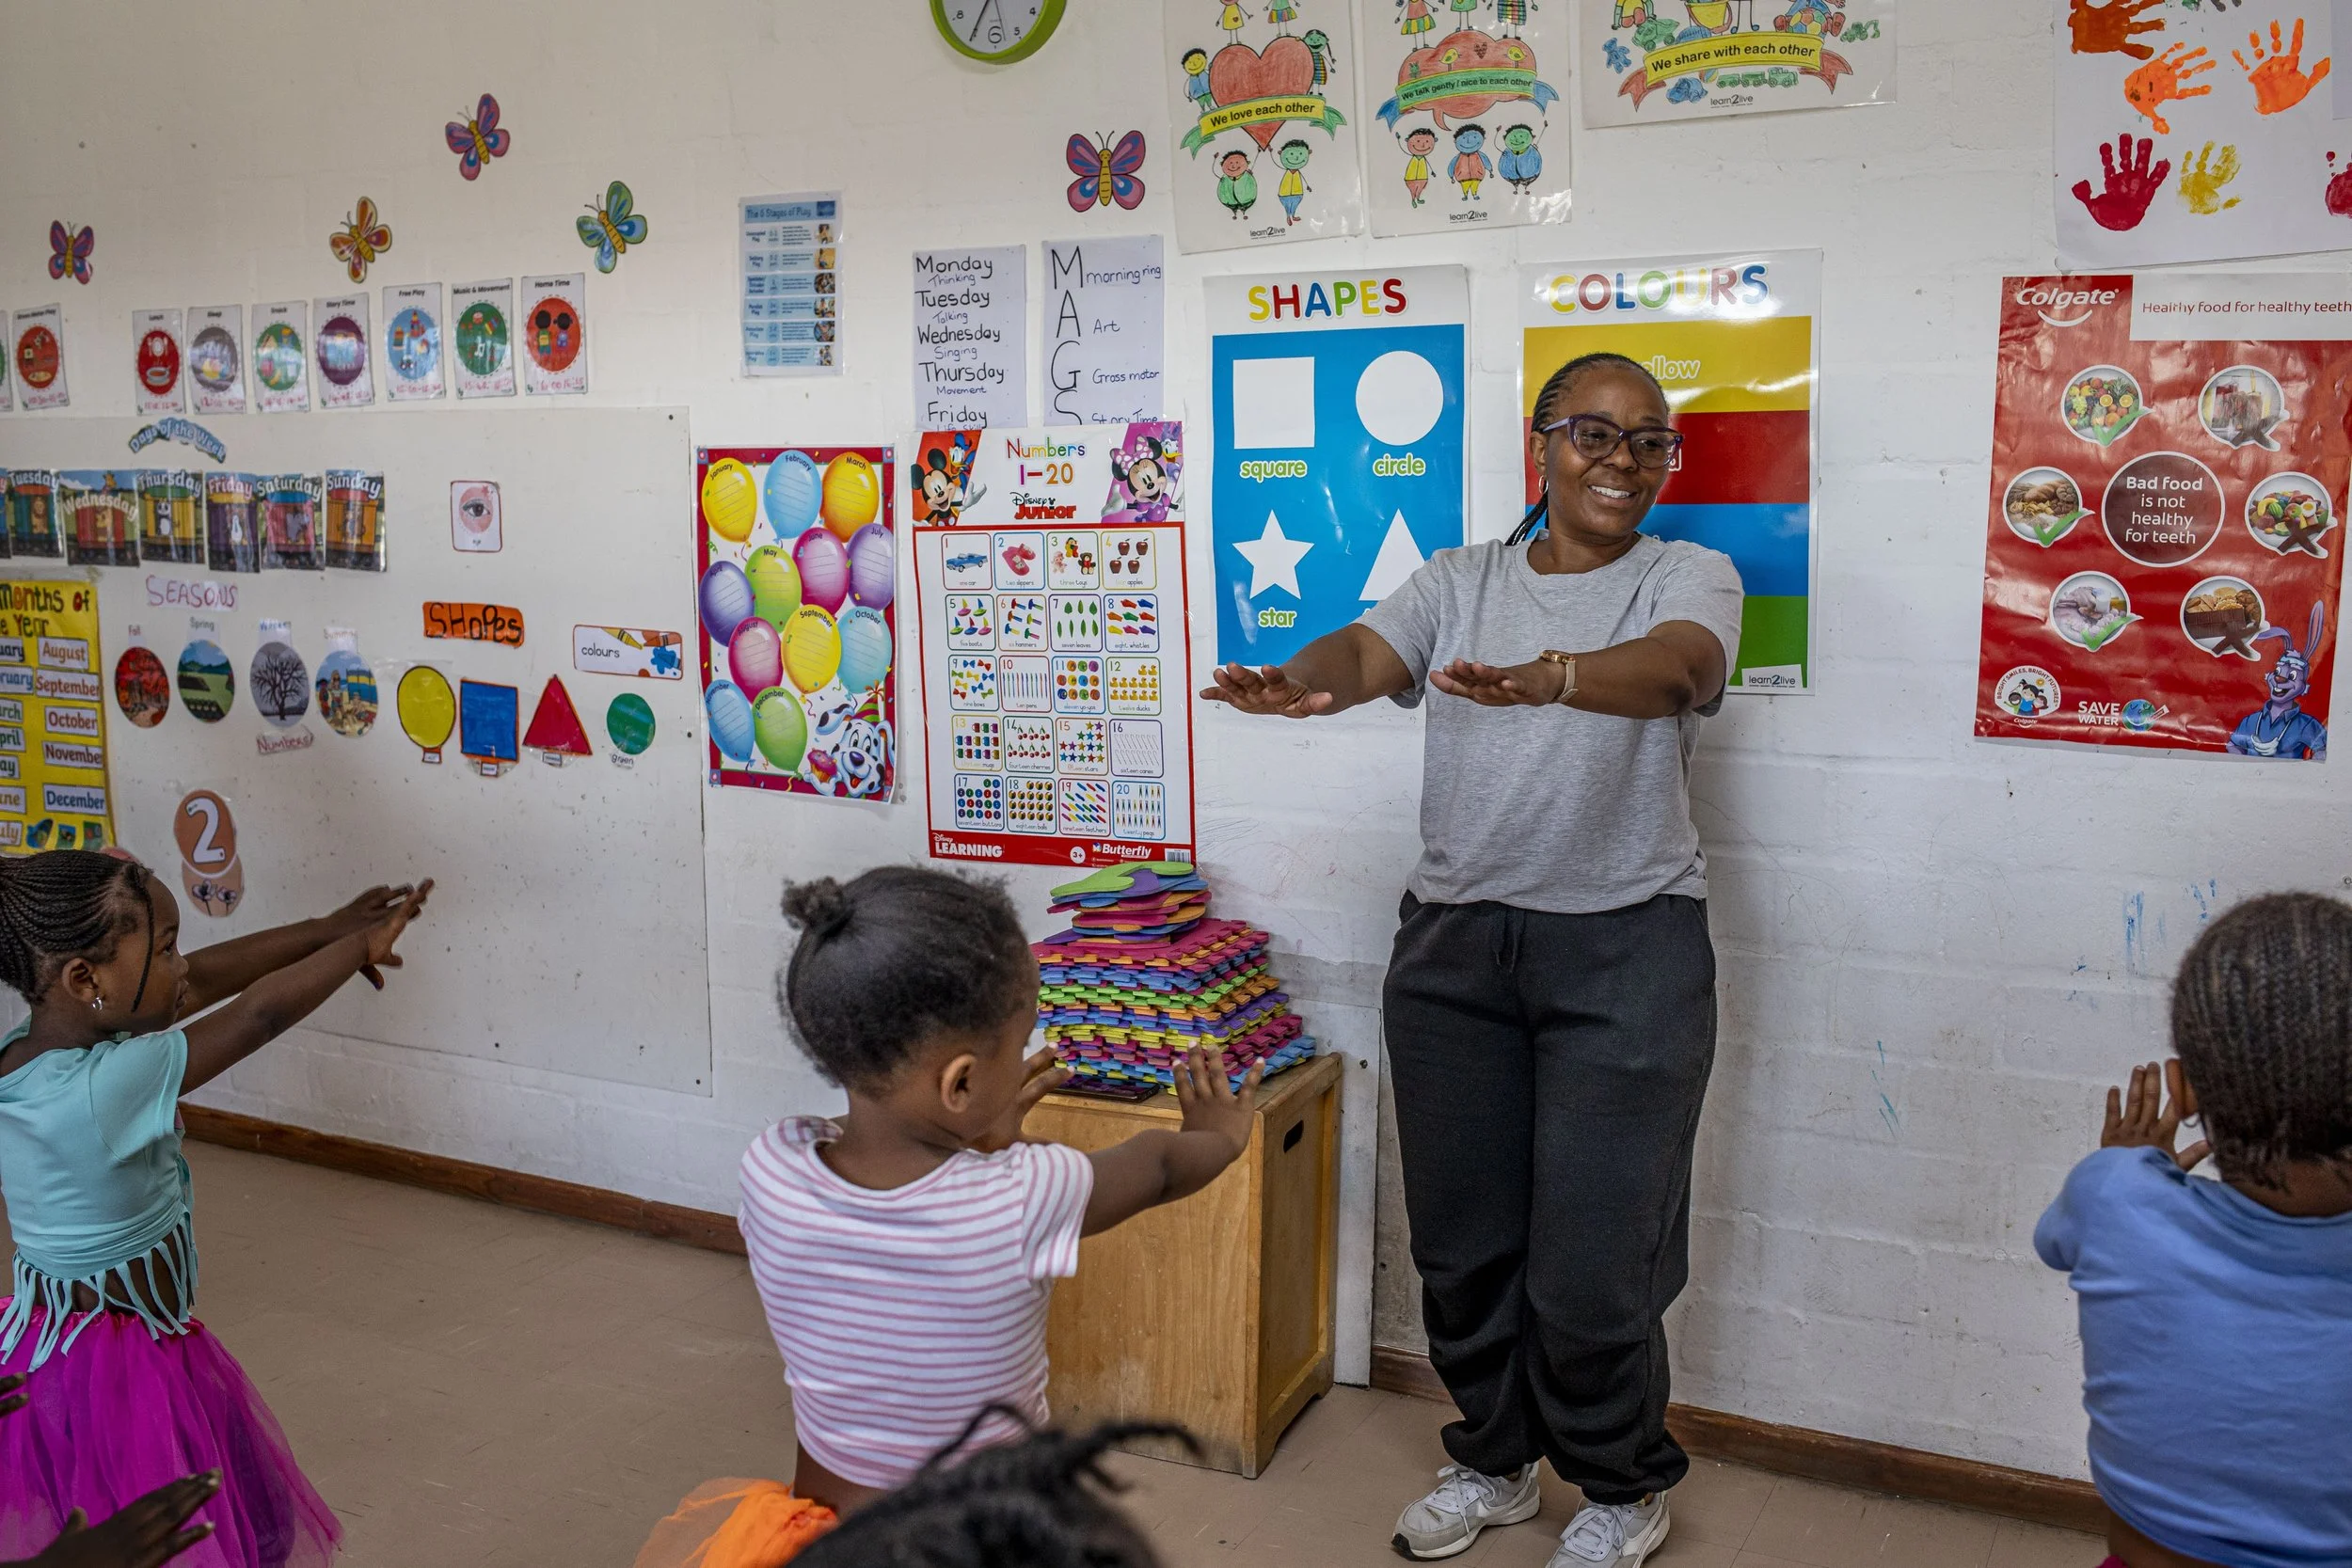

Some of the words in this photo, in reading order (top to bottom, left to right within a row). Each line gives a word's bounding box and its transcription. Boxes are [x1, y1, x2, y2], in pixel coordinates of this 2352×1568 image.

[957, 10, 963, 19] 8
[988, 26, 1002, 43] 6
[1014, 27, 1020, 36] 5
[1651, 58, 1672, 71] We
[1675, 50, 1710, 67] share
[1713, 44, 1740, 58] with
[1744, 43, 1776, 55] each
[1779, 45, 1815, 58] other
[1402, 92, 1413, 101] We
[1432, 82, 1454, 92] gently
[1510, 78, 1533, 87] other
[1710, 94, 1754, 105] learn2live
[1211, 116, 1228, 127] We
[1231, 109, 1252, 120] love
[1256, 103, 1282, 116] each
[1285, 103, 1315, 112] other
[916, 256, 993, 278] Monday
[1052, 246, 1083, 290] M
[1087, 271, 1140, 284] morning
[1143, 265, 1161, 278] ring
[928, 273, 976, 288] Thinking
[1549, 264, 1768, 314] COLOURS
[914, 288, 990, 308] Tuesday
[1248, 278, 1407, 322] SHAPES
[2016, 288, 2115, 309] Colgate
[1056, 290, 1081, 338] A
[1093, 319, 1120, 334] Art
[2143, 302, 2194, 315] Healthy
[2199, 301, 2230, 312] food
[2234, 301, 2255, 312] for
[2259, 302, 2311, 315] healthy
[2313, 302, 2352, 312] teeth
[932, 309, 968, 325] Talking
[917, 324, 1001, 344] Wednesday
[933, 346, 977, 361] Singing
[918, 361, 1004, 384] Thursday
[1051, 341, 1081, 390] G
[1092, 369, 1126, 384] Gross
[1130, 371, 1159, 380] motor
[937, 386, 986, 396] Movement
[928, 401, 987, 429] Friday
[131, 425, 157, 451] Days
[159, 421, 172, 437] of
[174, 422, 195, 441] the
[196, 430, 226, 461] Week
[1006, 436, 1086, 459] Numbers
[785, 454, 812, 471] February
[847, 457, 866, 469] March
[1373, 453, 1425, 477] circle
[710, 464, 733, 481] January
[1240, 460, 1307, 483] square
[8, 469, 60, 491] Tuesday
[138, 469, 202, 498] Thursday
[208, 476, 253, 499] Friday
[327, 471, 381, 499] Sunday
[2126, 477, 2157, 489] Bad
[2162, 477, 2203, 490] food
[257, 478, 322, 502] Saturday
[62, 490, 138, 521] Wednesday
[2141, 496, 2153, 507] is
[2157, 497, 2185, 508] not
[1015, 505, 1076, 519] Junior
[2132, 513, 2193, 528] healthy
[808, 532, 822, 542] June
[871, 528, 883, 538] July
[2125, 529, 2149, 543] for
[2153, 531, 2196, 544] teeth
[946, 538, 948, 547] 1
[998, 538, 1005, 547] 2
[1052, 537, 1058, 546] 3
[764, 548, 777, 557] May
[146, 575, 238, 609] SEASONS
[72, 591, 89, 611] of
[950, 599, 956, 609] 5
[1001, 598, 1006, 608] 6
[1054, 599, 1058, 609] 7
[1108, 598, 1114, 609] 8
[190, 618, 215, 631] Spring
[800, 609, 833, 629] September
[855, 610, 881, 626] October
[1259, 607, 1296, 627] star
[129, 626, 141, 636] Fall
[738, 622, 758, 636] August
[43, 641, 85, 663] August
[581, 643, 620, 658] colours
[953, 659, 957, 668] 9
[1003, 659, 1012, 669] 10
[1057, 660, 1064, 670] 11
[1110, 661, 1120, 672] 12
[36, 676, 100, 696] September
[1749, 674, 1796, 685] learn2live
[1997, 678, 2008, 699] BRIGHT
[2028, 668, 2049, 678] BRIGHT
[706, 683, 730, 704] November
[755, 690, 785, 710] December
[2078, 701, 2120, 715] SAVE
[48, 712, 97, 729] October
[956, 718, 966, 728] 13
[1007, 720, 1017, 730] 14
[1059, 721, 1070, 730] 15
[1113, 722, 1122, 732] 16
[2078, 715, 2119, 725] WATER
[45, 745, 103, 764] Novembe
[612, 754, 634, 765] green
[958, 777, 967, 786] 17
[1009, 780, 1019, 789] 18
[1062, 782, 1071, 791] 19
[1117, 784, 1129, 794] 20
[47, 790, 104, 809] December
[186, 796, 226, 863] 2
[935, 843, 1003, 858] LEARNING
[1102, 844, 1152, 859] Butterfly
